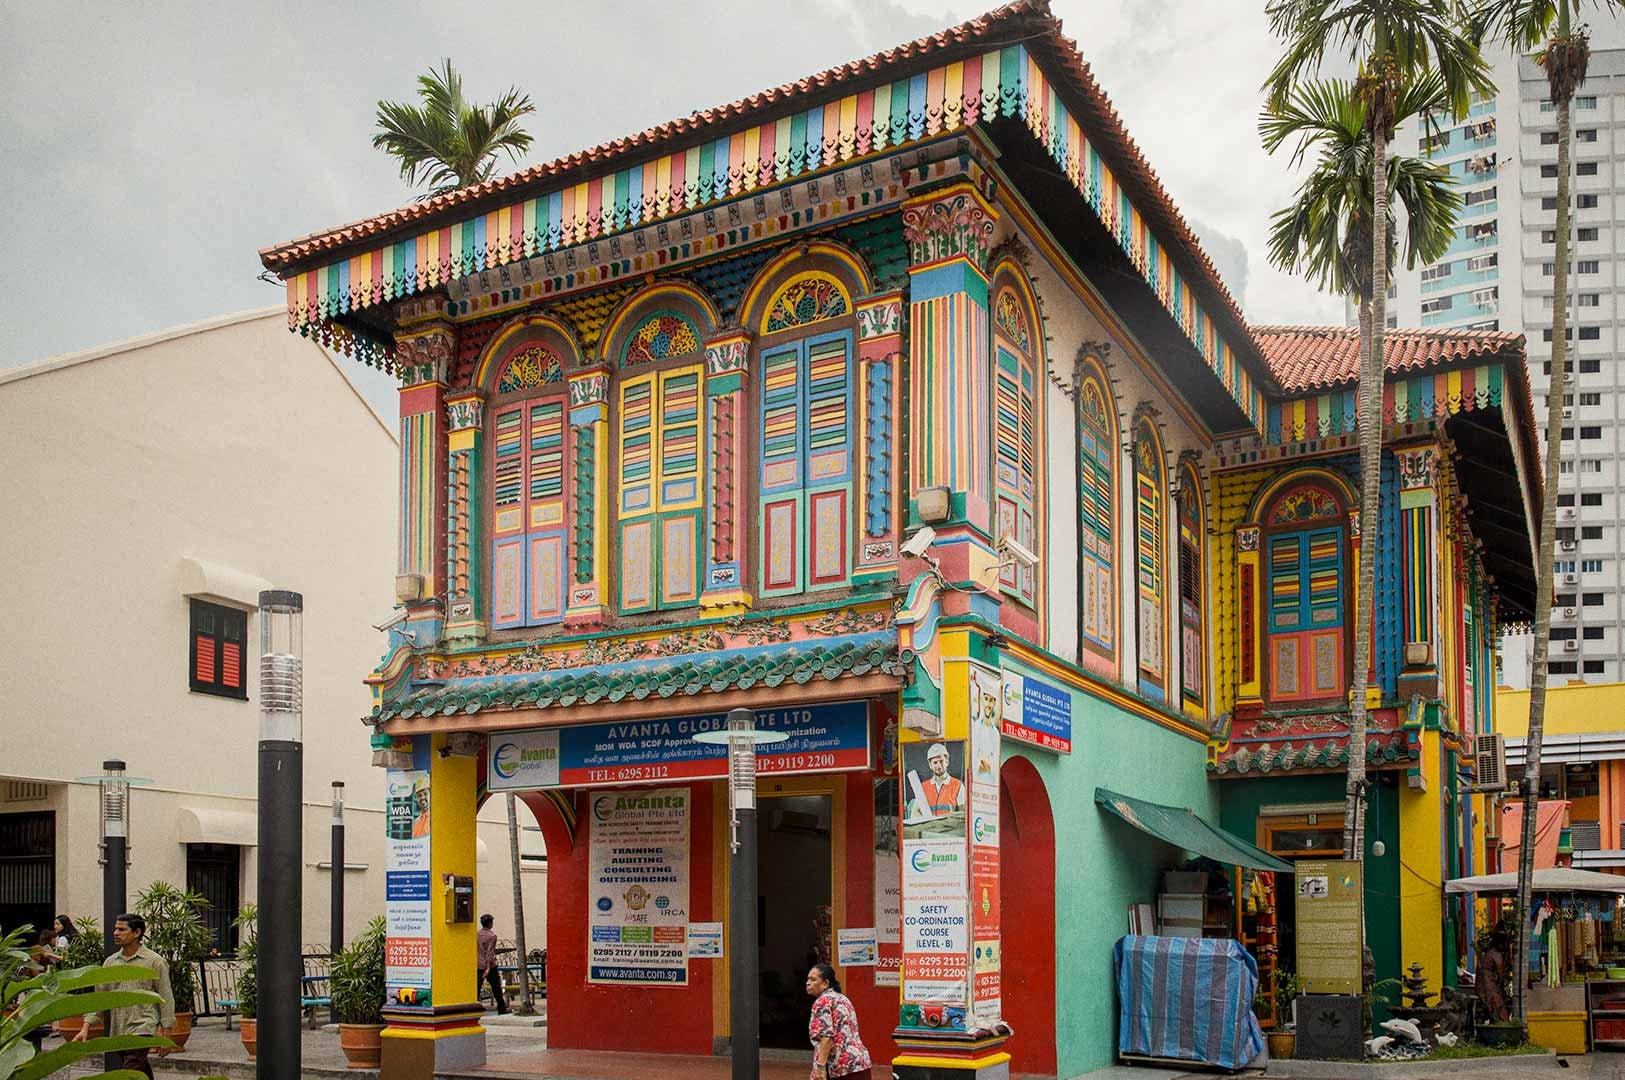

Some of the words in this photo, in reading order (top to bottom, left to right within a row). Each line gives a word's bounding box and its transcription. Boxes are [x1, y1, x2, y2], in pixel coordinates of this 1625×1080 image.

[608, 724, 670, 739] AVANTA
[678, 718, 728, 733] GLOBA
[784, 710, 812, 724] LTD
[595, 743, 614, 752] MOM
[641, 739, 662, 748] SCDF
[520, 747, 556, 762] Avanta
[588, 769, 615, 782] TEL:
[618, 767, 642, 780] 6295
[645, 766, 668, 779] 2112
[778, 755, 804, 768] 9119
[808, 754, 834, 766] 2200
[615, 796, 684, 810] Avanta
[392, 806, 411, 816] WDA
[614, 810, 644, 819] Global
[648, 810, 664, 818] Pte
[669, 809, 684, 817] Ltd
[931, 853, 958, 862] Avanta
[604, 866, 672, 874] CONSULTING
[920, 906, 948, 914] SAFETY
[905, 917, 964, 925] CO-ORDINATOR
[920, 928, 949, 936] COURSE
[916, 940, 940, 948] (LEVEL
[390, 946, 408, 955] 6295
[408, 947, 428, 956] 2112
[594, 948, 614, 956] 6295
[615, 948, 632, 956] 2112
[390, 956, 408, 965] 9119
[408, 957, 428, 966] 2200
[919, 957, 942, 966] 6295
[943, 957, 966, 966] 2112
[599, 968, 677, 981] www.avanta.com.sg
[920, 968, 942, 977] 9119
[943, 969, 966, 977] 2200
